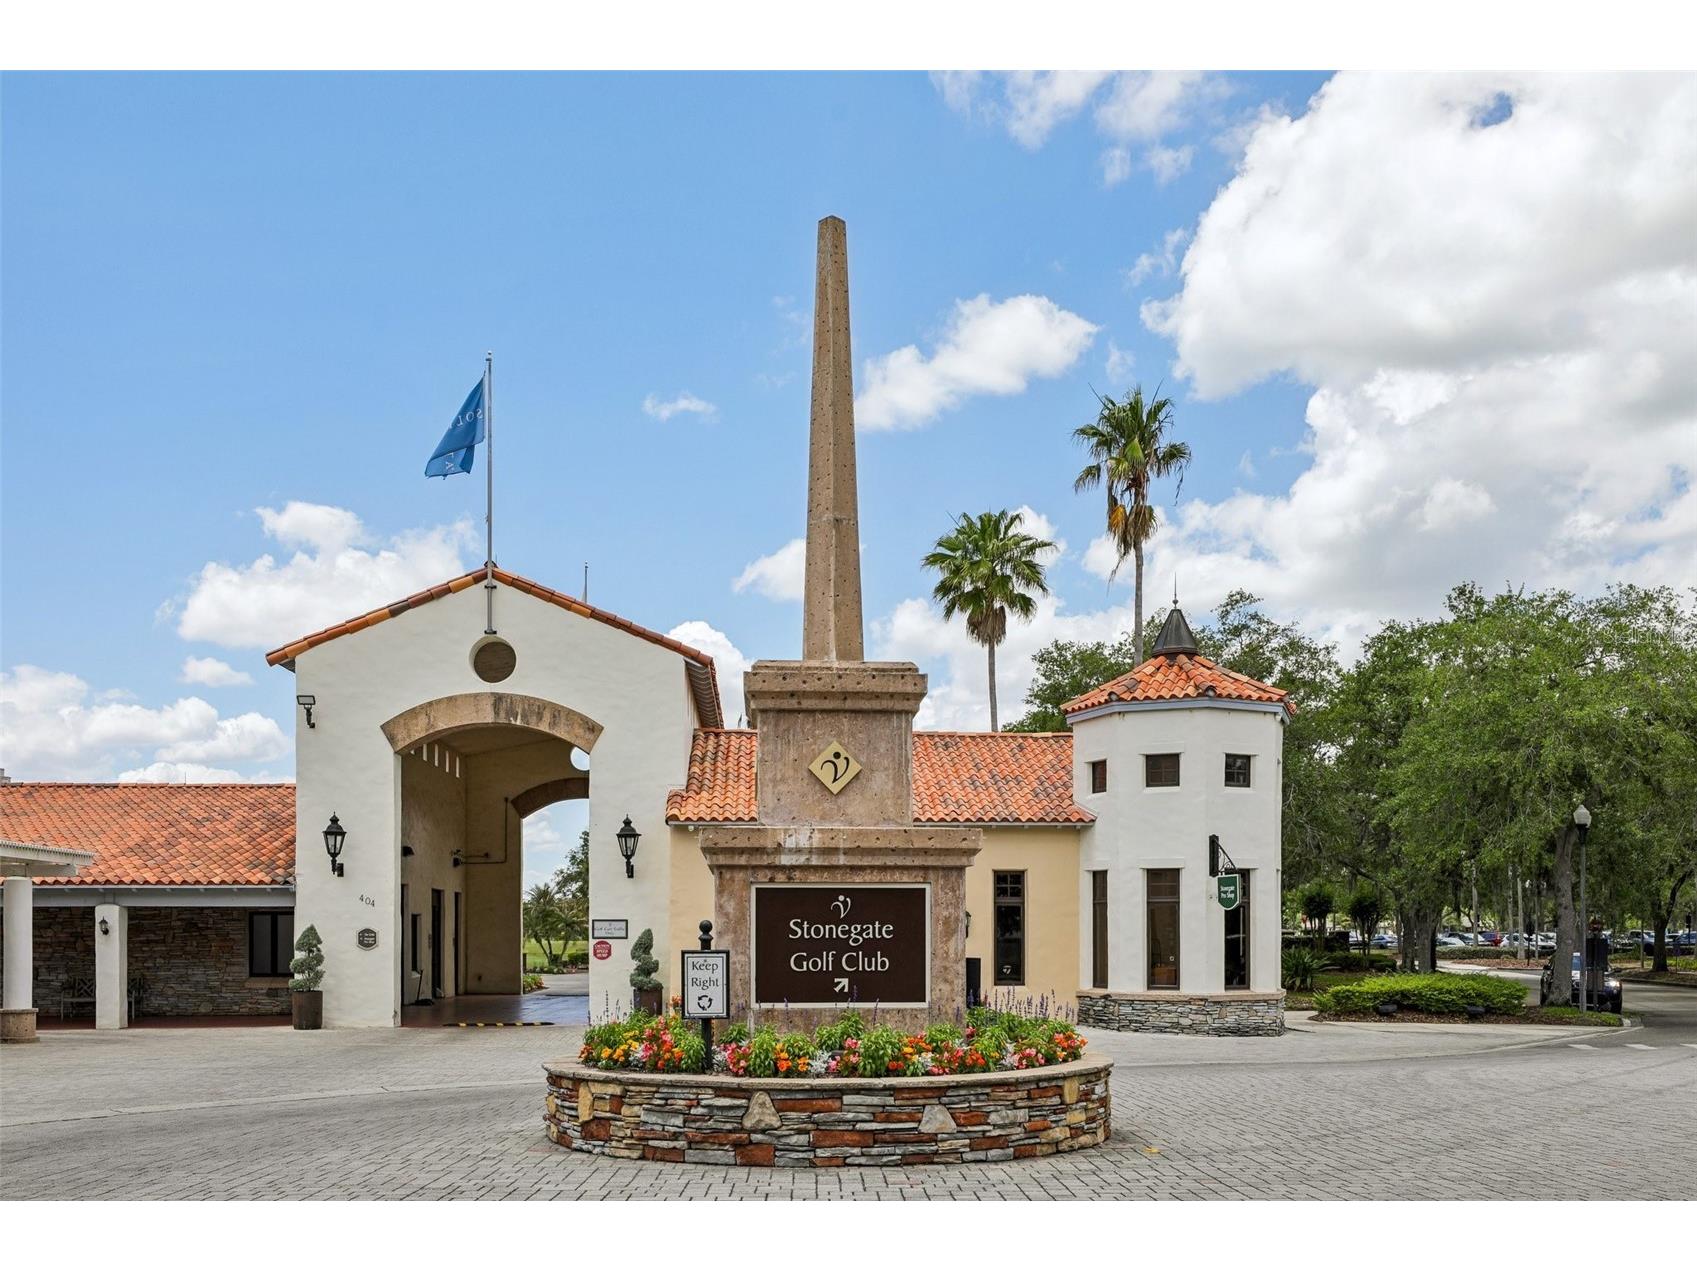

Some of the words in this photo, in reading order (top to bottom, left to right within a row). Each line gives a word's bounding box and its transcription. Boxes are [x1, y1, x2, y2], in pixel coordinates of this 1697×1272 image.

[359, 894, 375, 907] 404
[788, 918, 894, 946] Stonegate
[691, 960, 719, 974] Keep
[790, 951, 836, 972] Golf
[841, 951, 890, 972] Club
[691, 977, 719, 990] Right
